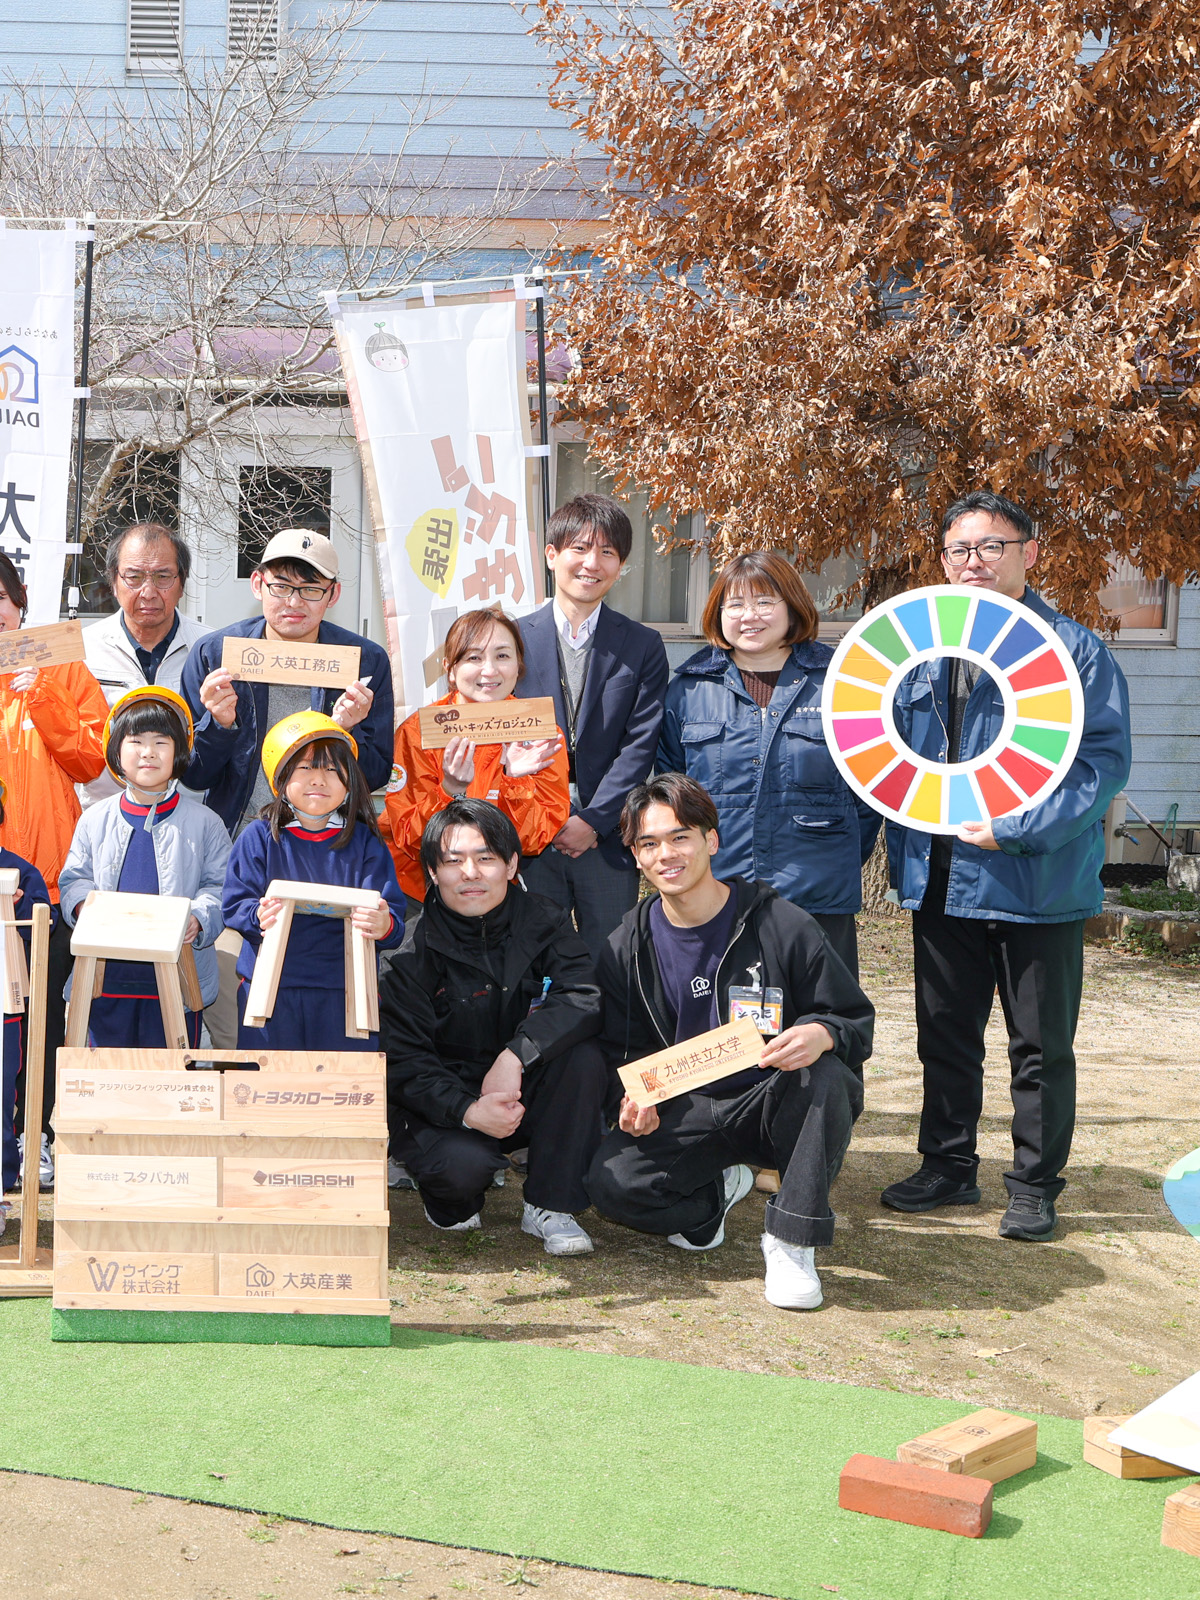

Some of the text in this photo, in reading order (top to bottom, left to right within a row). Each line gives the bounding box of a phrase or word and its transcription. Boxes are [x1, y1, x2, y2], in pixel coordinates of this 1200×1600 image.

[240, 667, 264, 675] DAIEI
[270, 655, 341, 673] 大英工務店
[443, 716, 542, 734] みらいキッズプロジェクト
[693, 989, 712, 998] DAIEI
[663, 1035, 742, 1078] 九州共立大学
[78, 1090, 95, 1098] APM
[252, 1090, 375, 1106] トヨタカローラ博多
[87, 1172, 120, 1182] 株式会社
[268, 1173, 355, 1186] ISHIBASHI
[122, 1263, 184, 1278] ウイング
[122, 1279, 181, 1294] 株式会社
[282, 1272, 353, 1291] 大英産業
